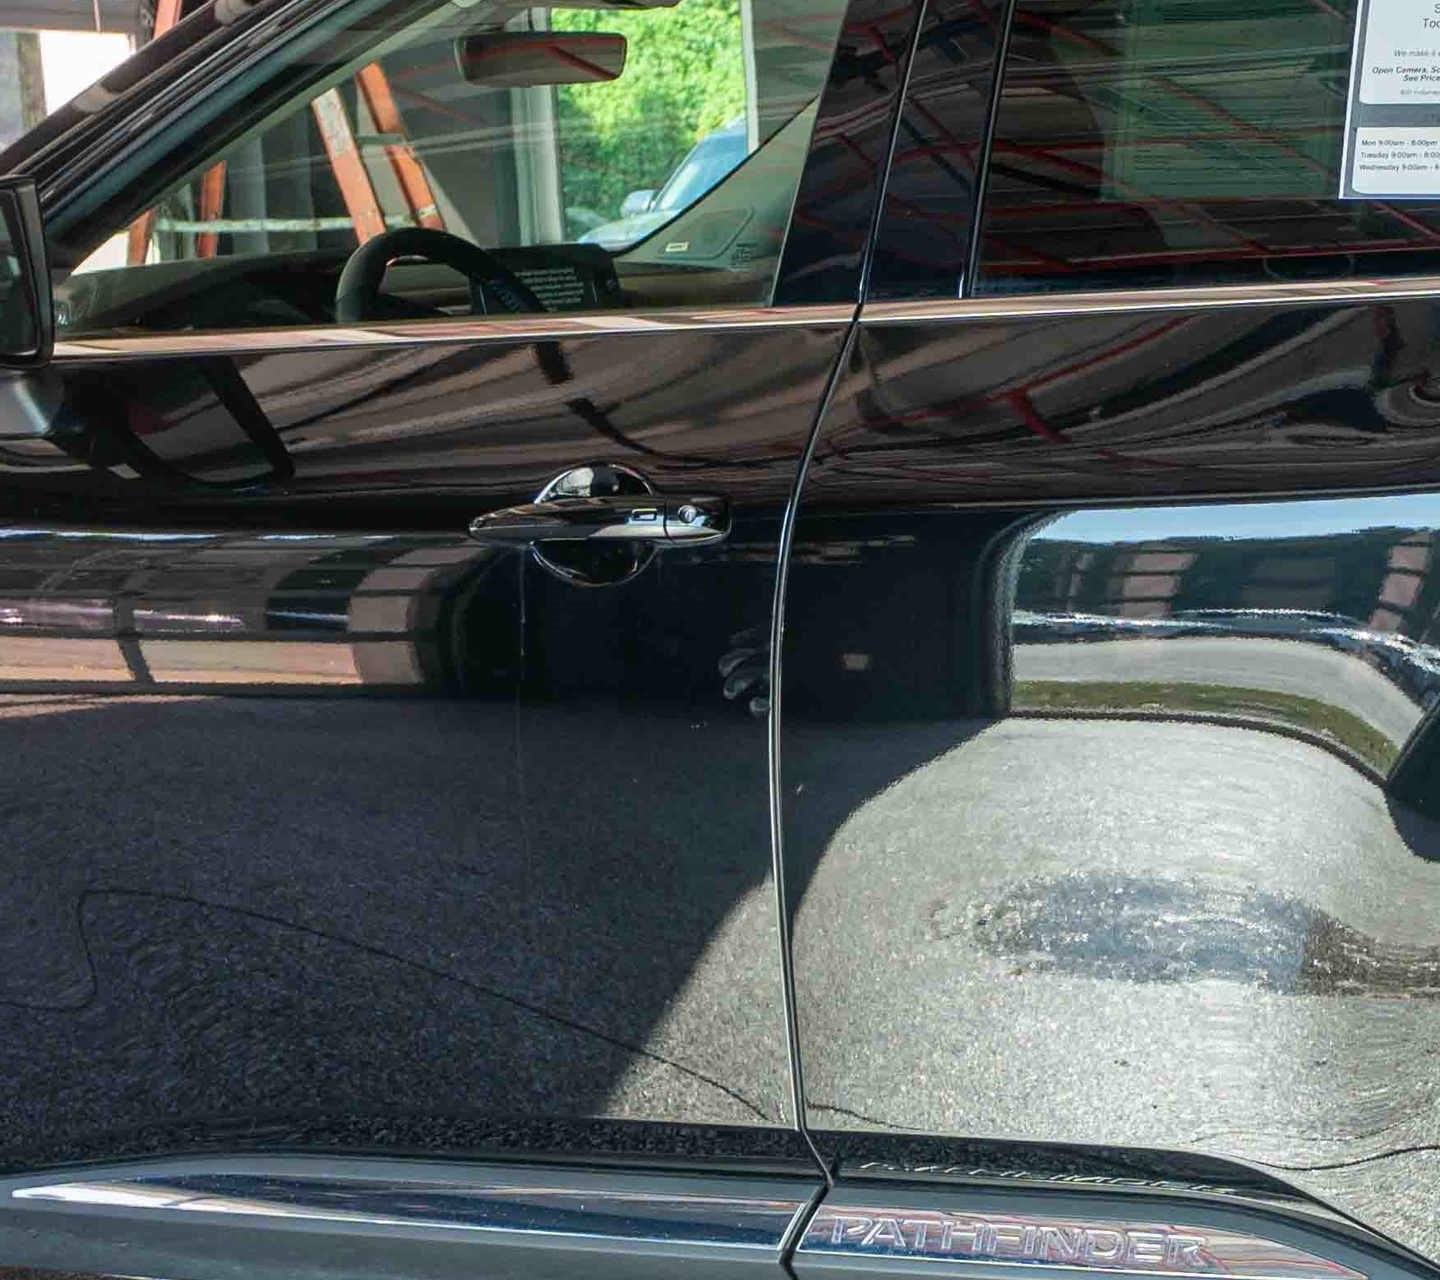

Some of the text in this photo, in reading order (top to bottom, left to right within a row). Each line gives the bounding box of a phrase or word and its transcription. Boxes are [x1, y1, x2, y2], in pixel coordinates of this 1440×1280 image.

[1372, 66, 1394, 75] Open
[1403, 74, 1418, 82] See
[830, 1215, 1216, 1268] PATHFINDER
